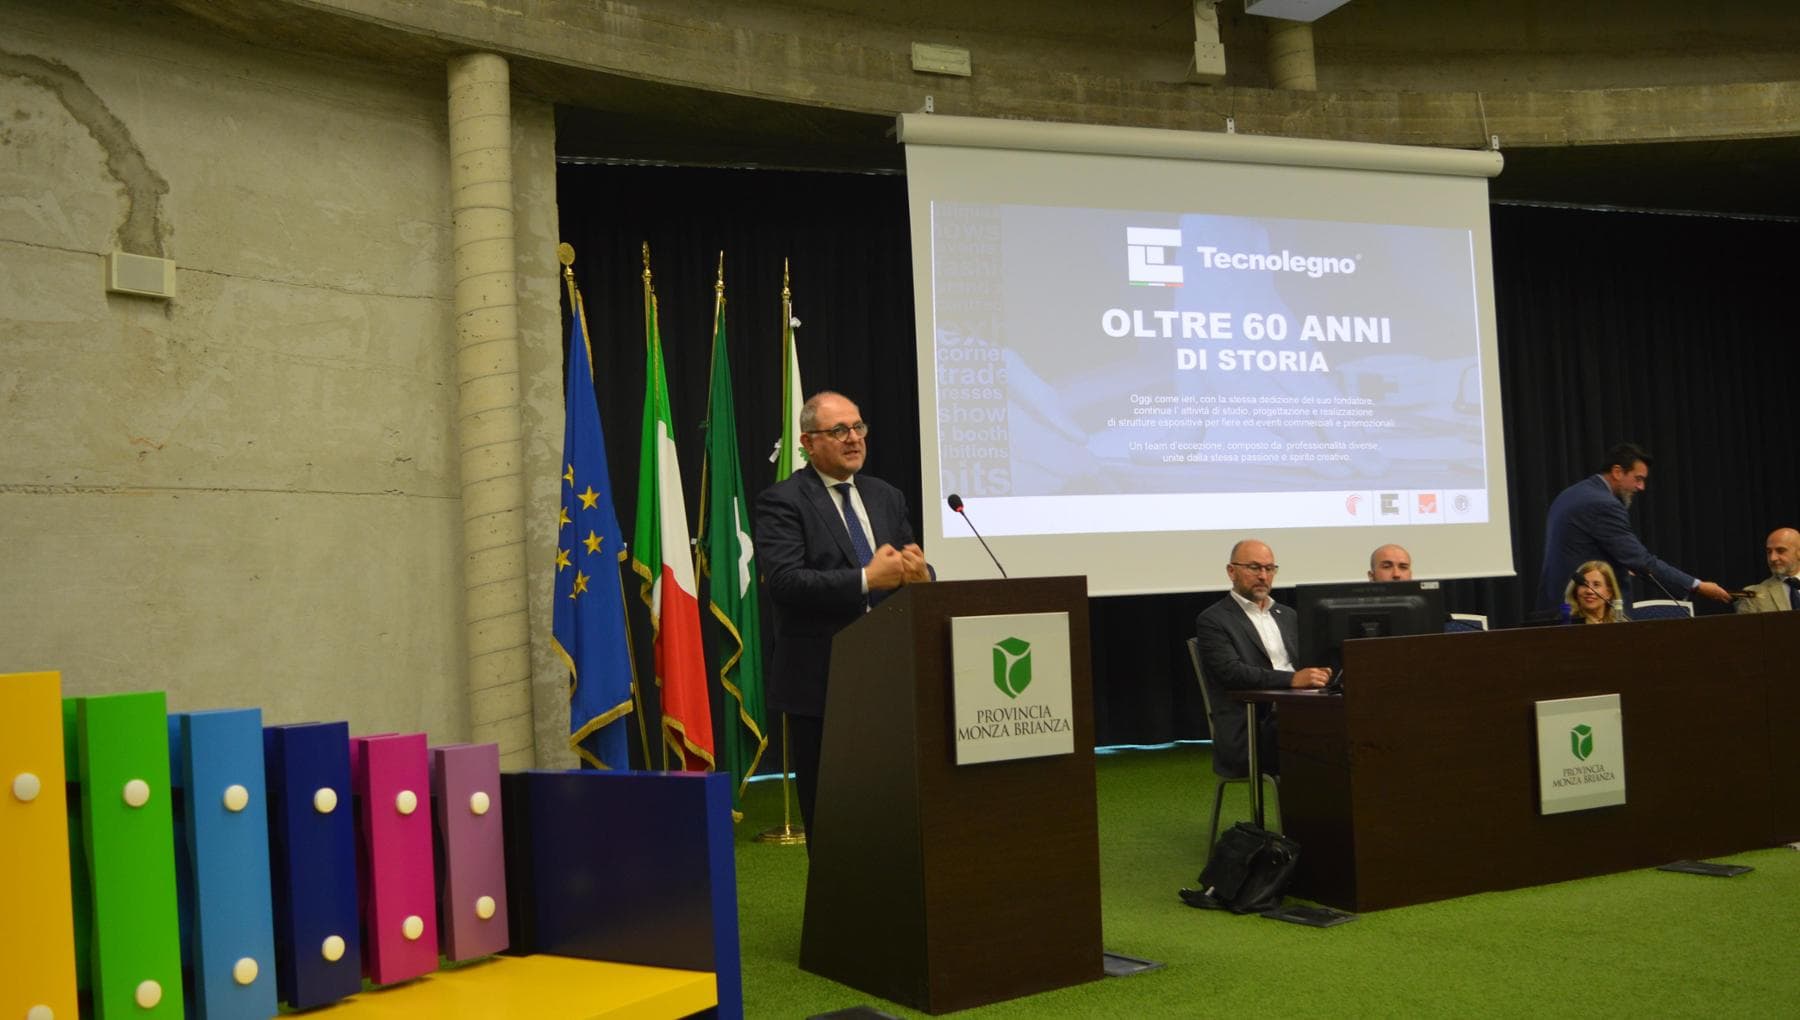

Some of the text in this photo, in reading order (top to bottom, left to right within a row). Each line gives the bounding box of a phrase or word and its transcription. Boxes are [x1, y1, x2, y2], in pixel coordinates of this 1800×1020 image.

[1197, 246, 1356, 278] Tecnolegno
[1101, 308, 1392, 344] OLTRE 60 ANNI
[1177, 347, 1330, 373] DI STORIA
[939, 387, 1003, 400] resses
[1130, 393, 1153, 405] Oggi
[1154, 395, 1179, 404] come
[1200, 395, 1217, 404] con
[939, 402, 1007, 423] show
[1212, 407, 1221, 416] di
[1107, 417, 1117, 427] di
[1118, 417, 1156, 428] strutture
[1158, 418, 1204, 429] espositive
[1128, 441, 1143, 451] Un
[1163, 453, 1185, 463] unite
[977, 705, 1052, 724] PROVINCIA
[958, 718, 1072, 741] MONZA BRIANZA
[1562, 764, 1606, 777] PROVINCIA
[1552, 771, 1615, 789] MONZA BRIANZA
